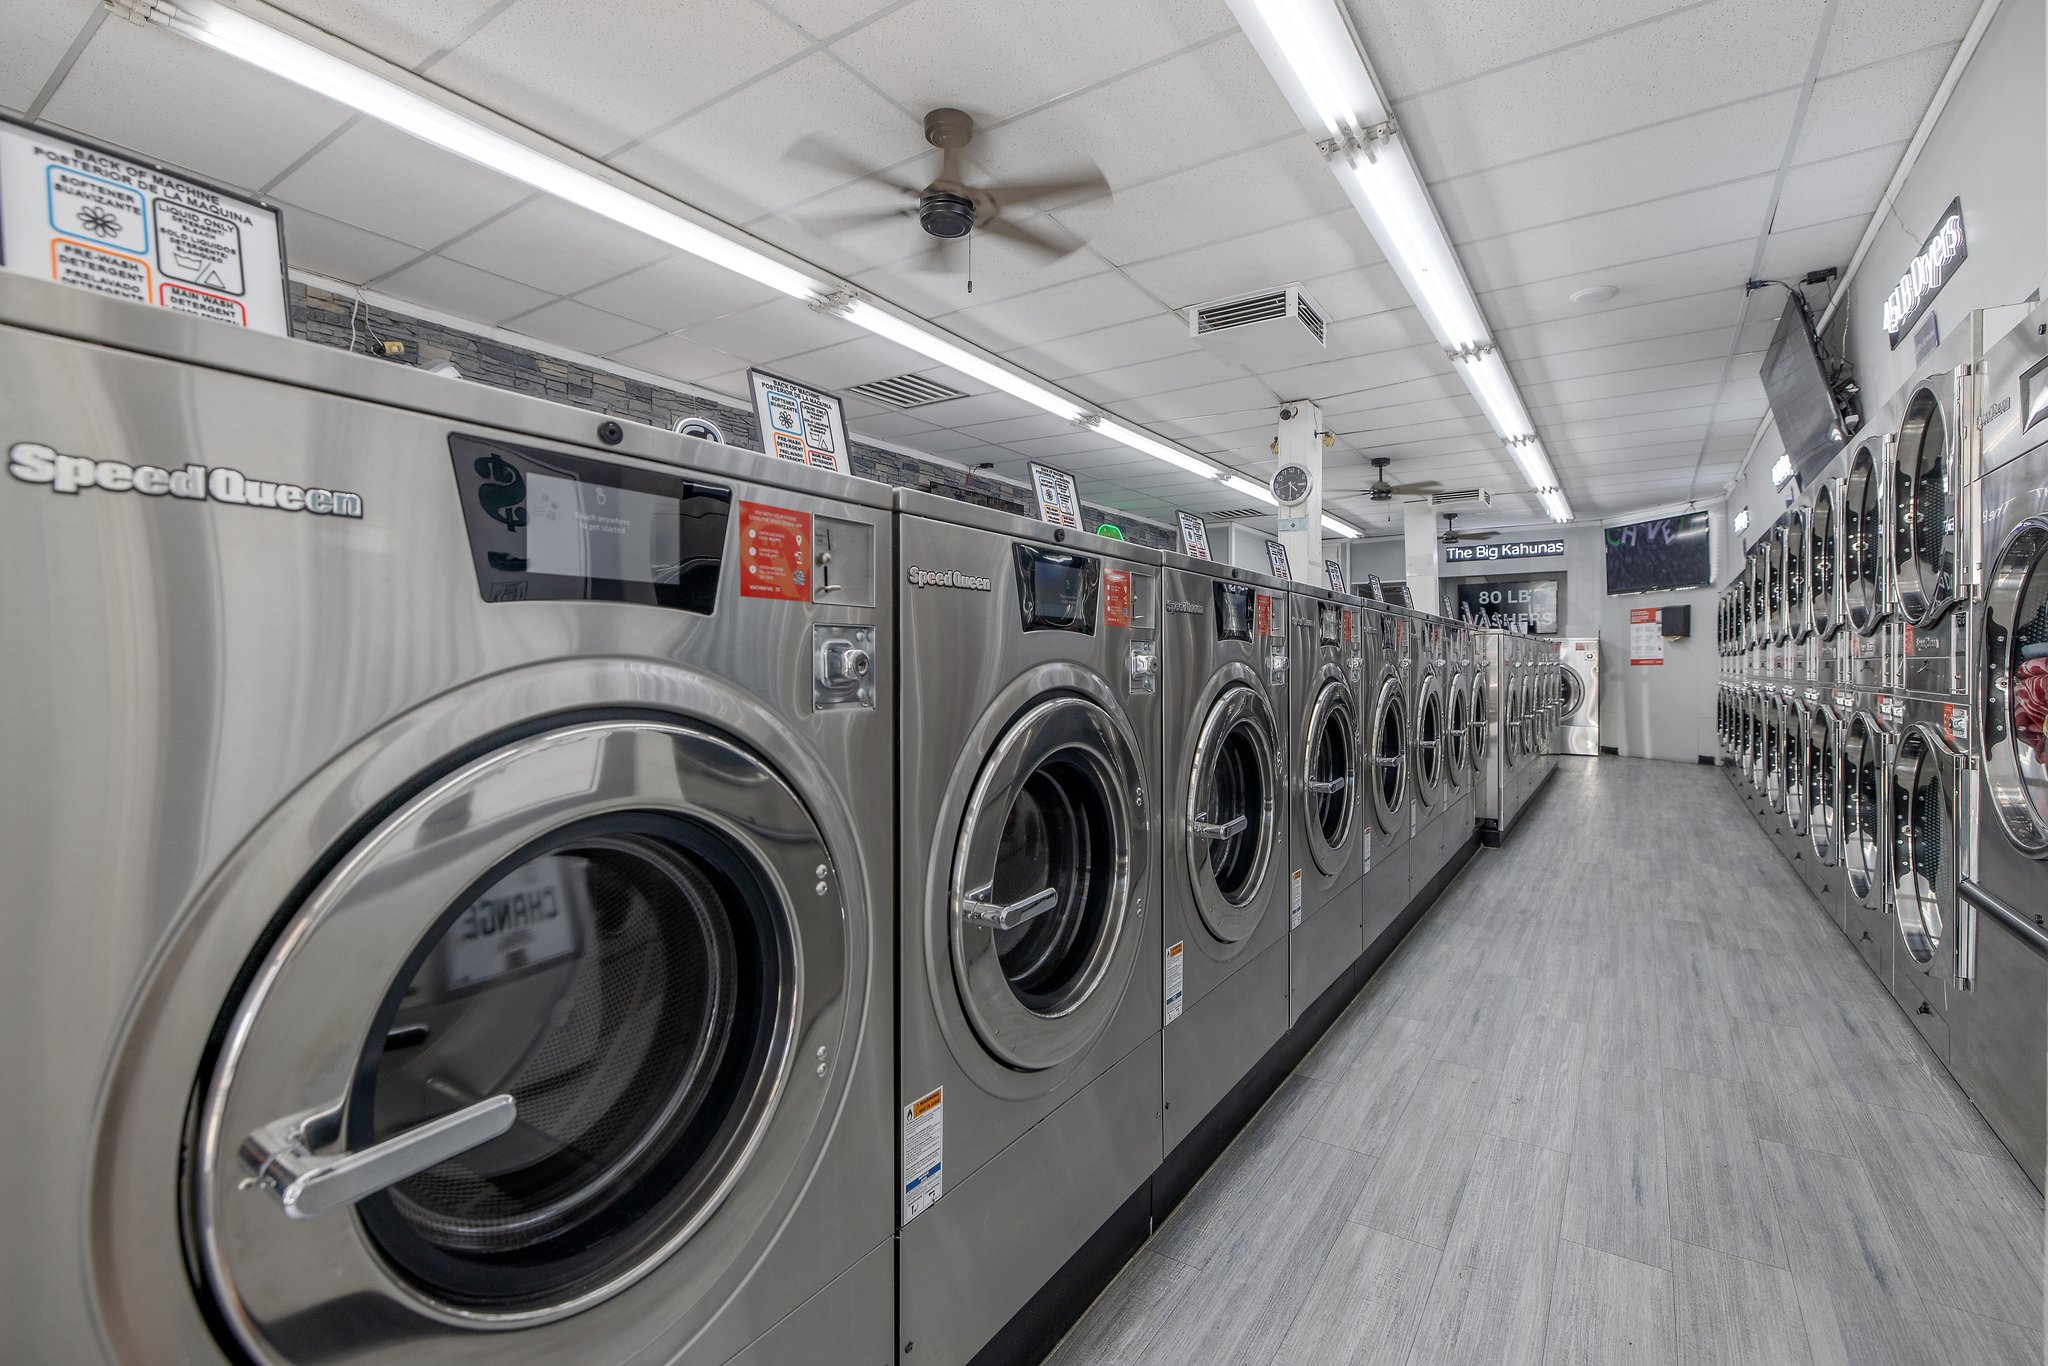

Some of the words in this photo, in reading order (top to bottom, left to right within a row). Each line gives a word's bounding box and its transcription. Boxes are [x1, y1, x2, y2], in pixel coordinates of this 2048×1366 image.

[34, 146, 132, 186] POSTERIOR
[138, 180, 158, 194] DE
[163, 188, 182, 202] LA
[187, 197, 253, 226] MAQUINA
[61, 174, 135, 203] SOFTENER
[74, 149, 121, 172] BACK
[126, 166, 147, 178] OF
[153, 175, 220, 206] MACHINE
[54, 183, 142, 216] SUAVIZANTE
[158, 202, 200, 222] LIQUID
[203, 218, 234, 233] ONLY
[160, 227, 188, 240] SOLO
[191, 237, 237, 255] LIQUIDOS
[182, 225, 216, 240] BLEACH
[58, 255, 144, 282] DETERGENT
[64, 245, 138, 271] PRE-WASH
[66, 269, 140, 293] PRELAVADO
[170, 296, 236, 318] DETERGENT
[171, 287, 199, 300] MAIN
[202, 296, 234, 309] WASH
[761, 381, 794, 397] POSTERIOR
[771, 395, 796, 407] SOFTENER
[574, 511, 596, 521] Touch
[598, 516, 631, 526] anywhere
[601, 525, 626, 534] started
[1446, 547, 1473, 559] The
[1476, 545, 1498, 560] Big
[1501, 542, 1564, 556] Kahunas
[1478, 590, 1502, 604] 80
[1507, 589, 1531, 604] LB
